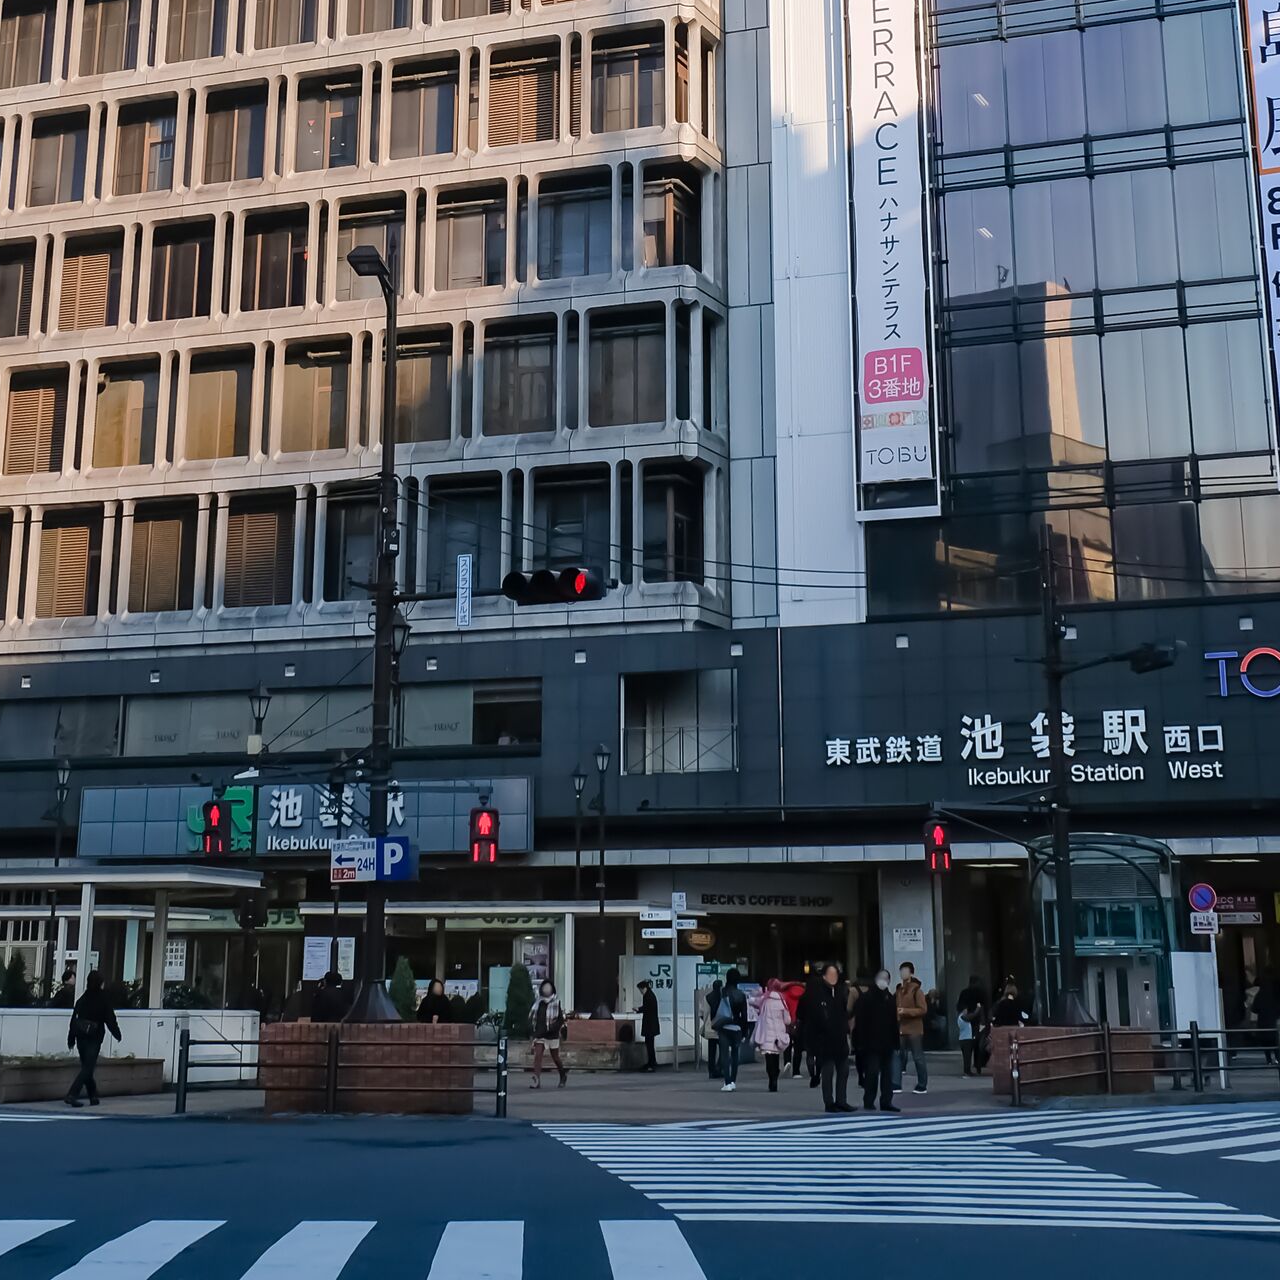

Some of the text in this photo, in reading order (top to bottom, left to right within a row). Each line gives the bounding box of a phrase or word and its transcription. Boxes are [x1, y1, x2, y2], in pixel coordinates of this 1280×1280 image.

[878, 196, 901, 341] ハナサンテラス
[874, 353, 912, 375] B1F
[868, 377, 922, 399] 3番地
[865, 444, 927, 466] TOBU
[458, 557, 471, 624] スクランブル式
[825, 706, 1225, 766] 東武鉄道 池袋駅 西口
[967, 758, 1225, 787] Ikebukur Station West
[266, 835, 333, 853] Ikebukur
[357, 857, 375, 872] 24H
[383, 842, 404, 876] P
[700, 893, 834, 908] BECK'S COFFEE SHOP
[649, 964, 672, 977] JR
